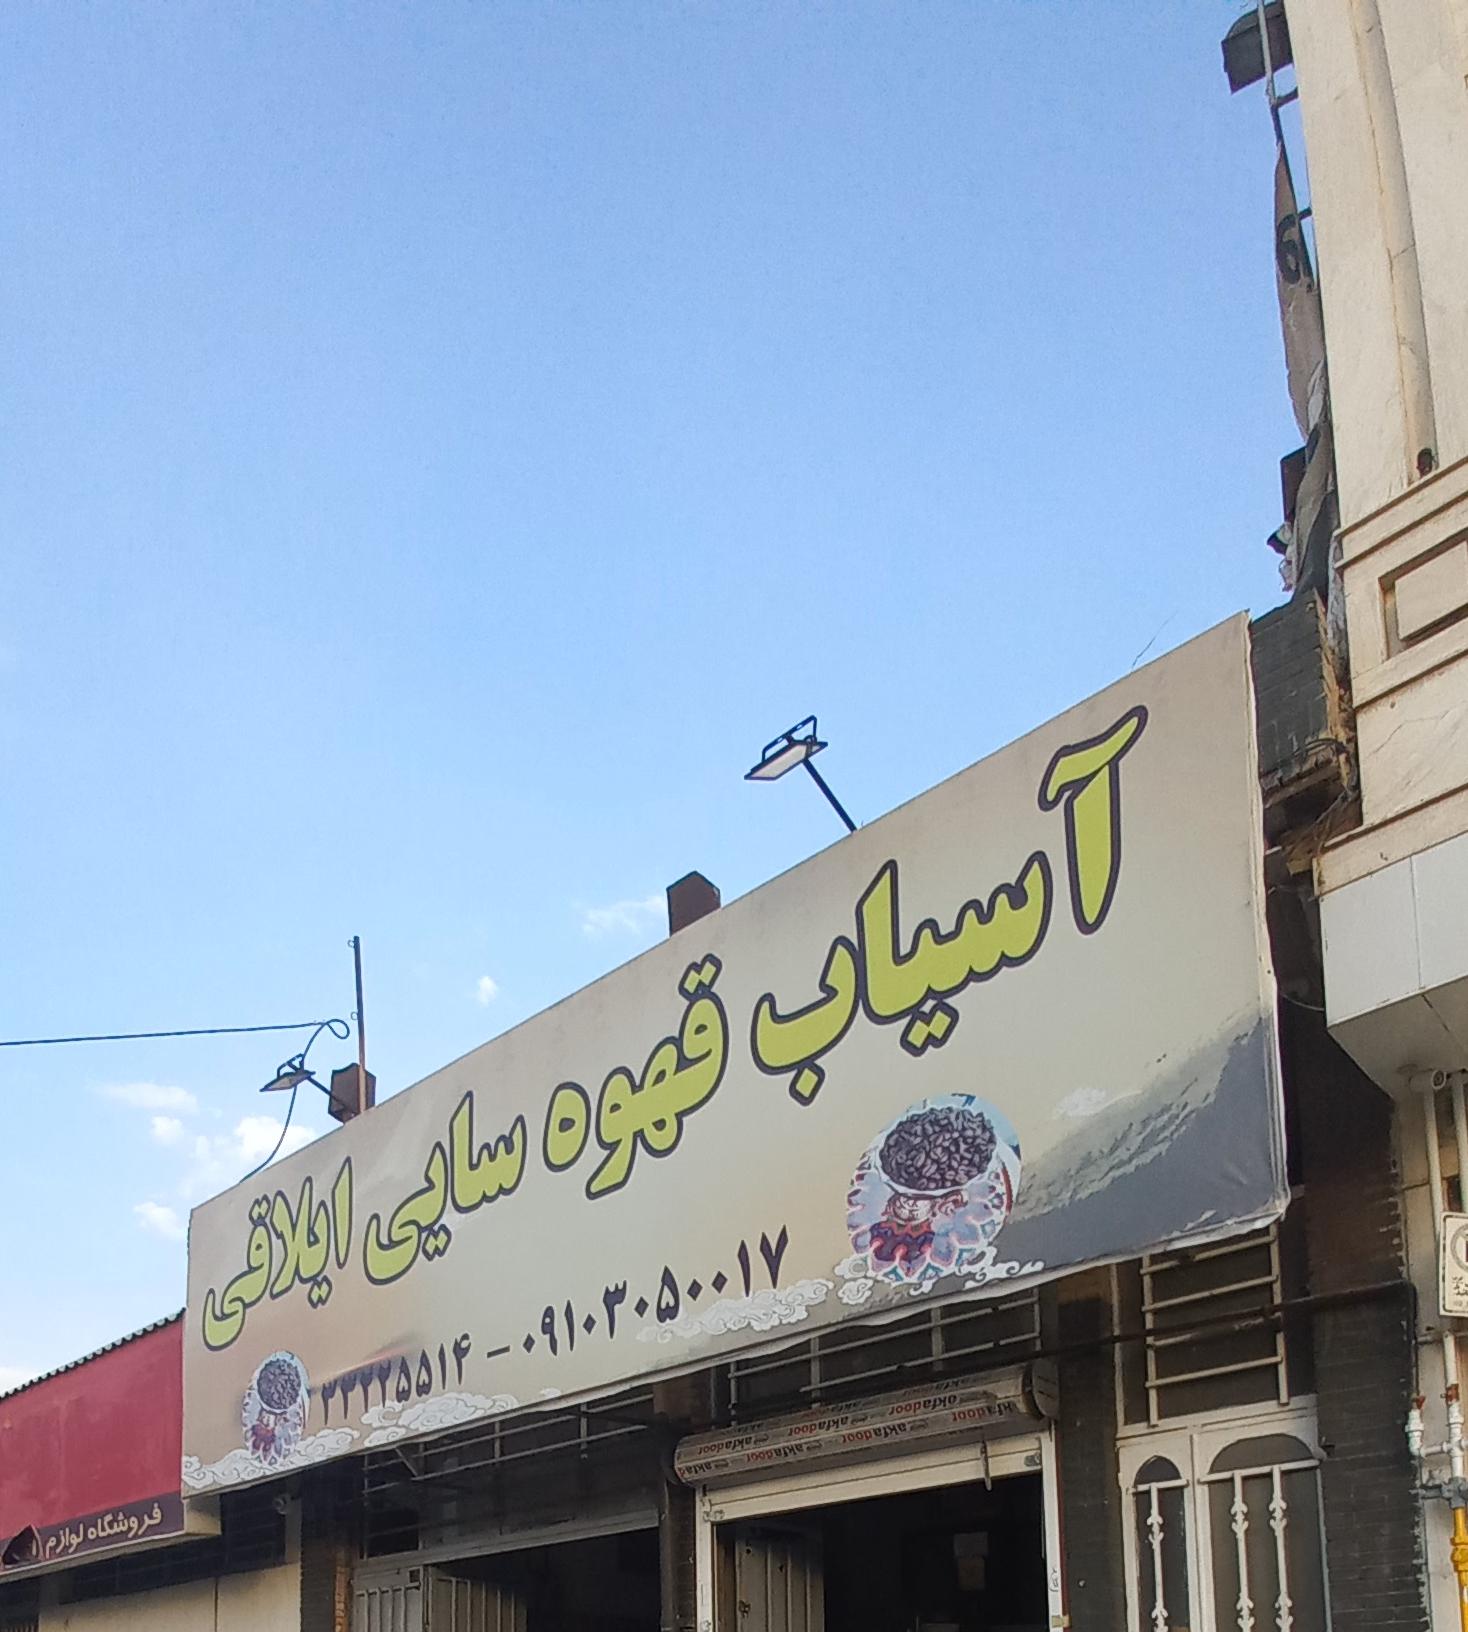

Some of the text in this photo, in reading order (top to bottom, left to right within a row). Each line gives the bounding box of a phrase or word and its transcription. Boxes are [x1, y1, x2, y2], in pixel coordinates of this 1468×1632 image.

[202, 705, 1148, 1351] آسیاب قهوه سایی ایلاقی
[521, 1224, 789, 1358] ۰۹۱۰۳۰۵۰۰۱۷
[787, 1416, 849, 1436] akfadoor
[840, 1420, 908, 1444] akfadoor
[697, 1436, 754, 1455] akfadoor
[745, 1443, 805, 1462] akfadoor
[87, 1502, 163, 1540] فروشگاه
[45, 1523, 85, 1560] لوازم
